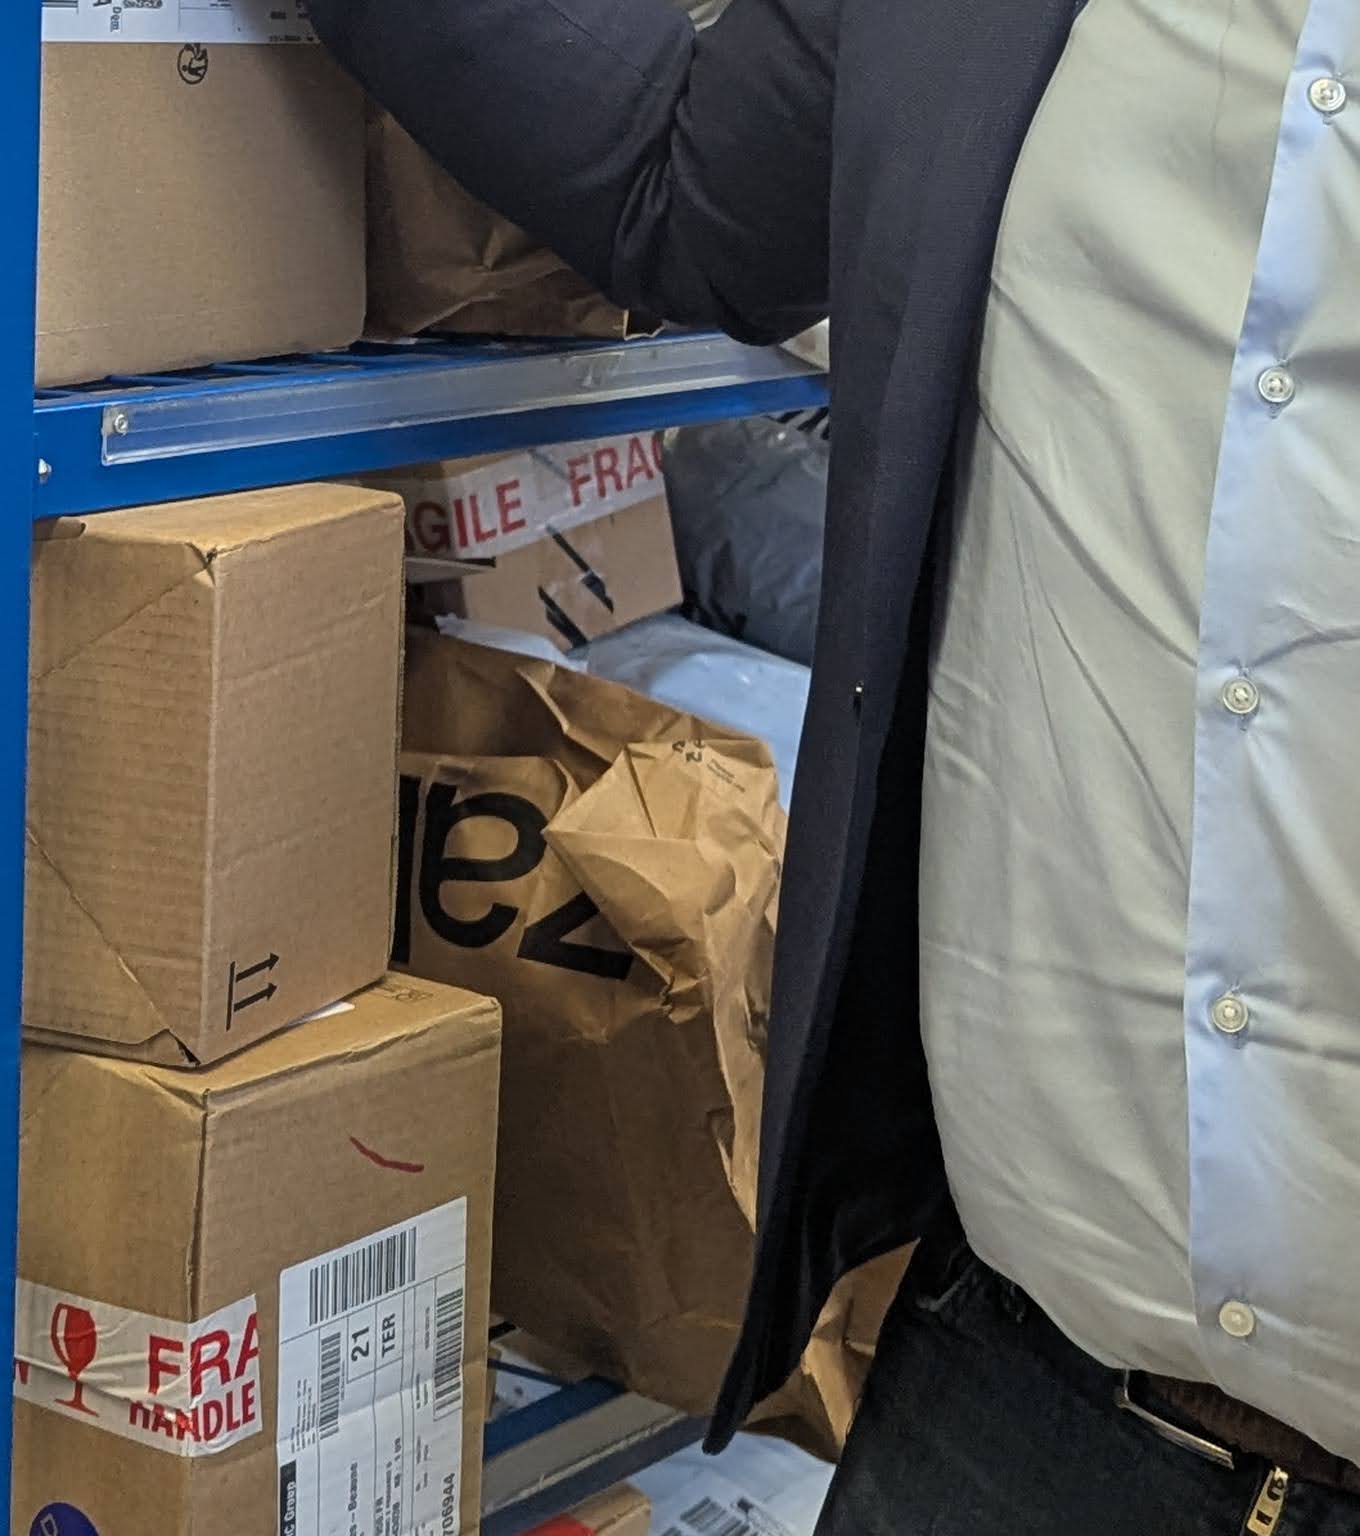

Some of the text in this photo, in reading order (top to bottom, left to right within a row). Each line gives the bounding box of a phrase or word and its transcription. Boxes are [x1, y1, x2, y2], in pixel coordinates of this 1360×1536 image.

[350, 1326, 371, 1363] 21
[379, 1313, 398, 1358] TER
[129, 1382, 256, 1443] HANDLE
[284, 1480, 297, 1521] Group
